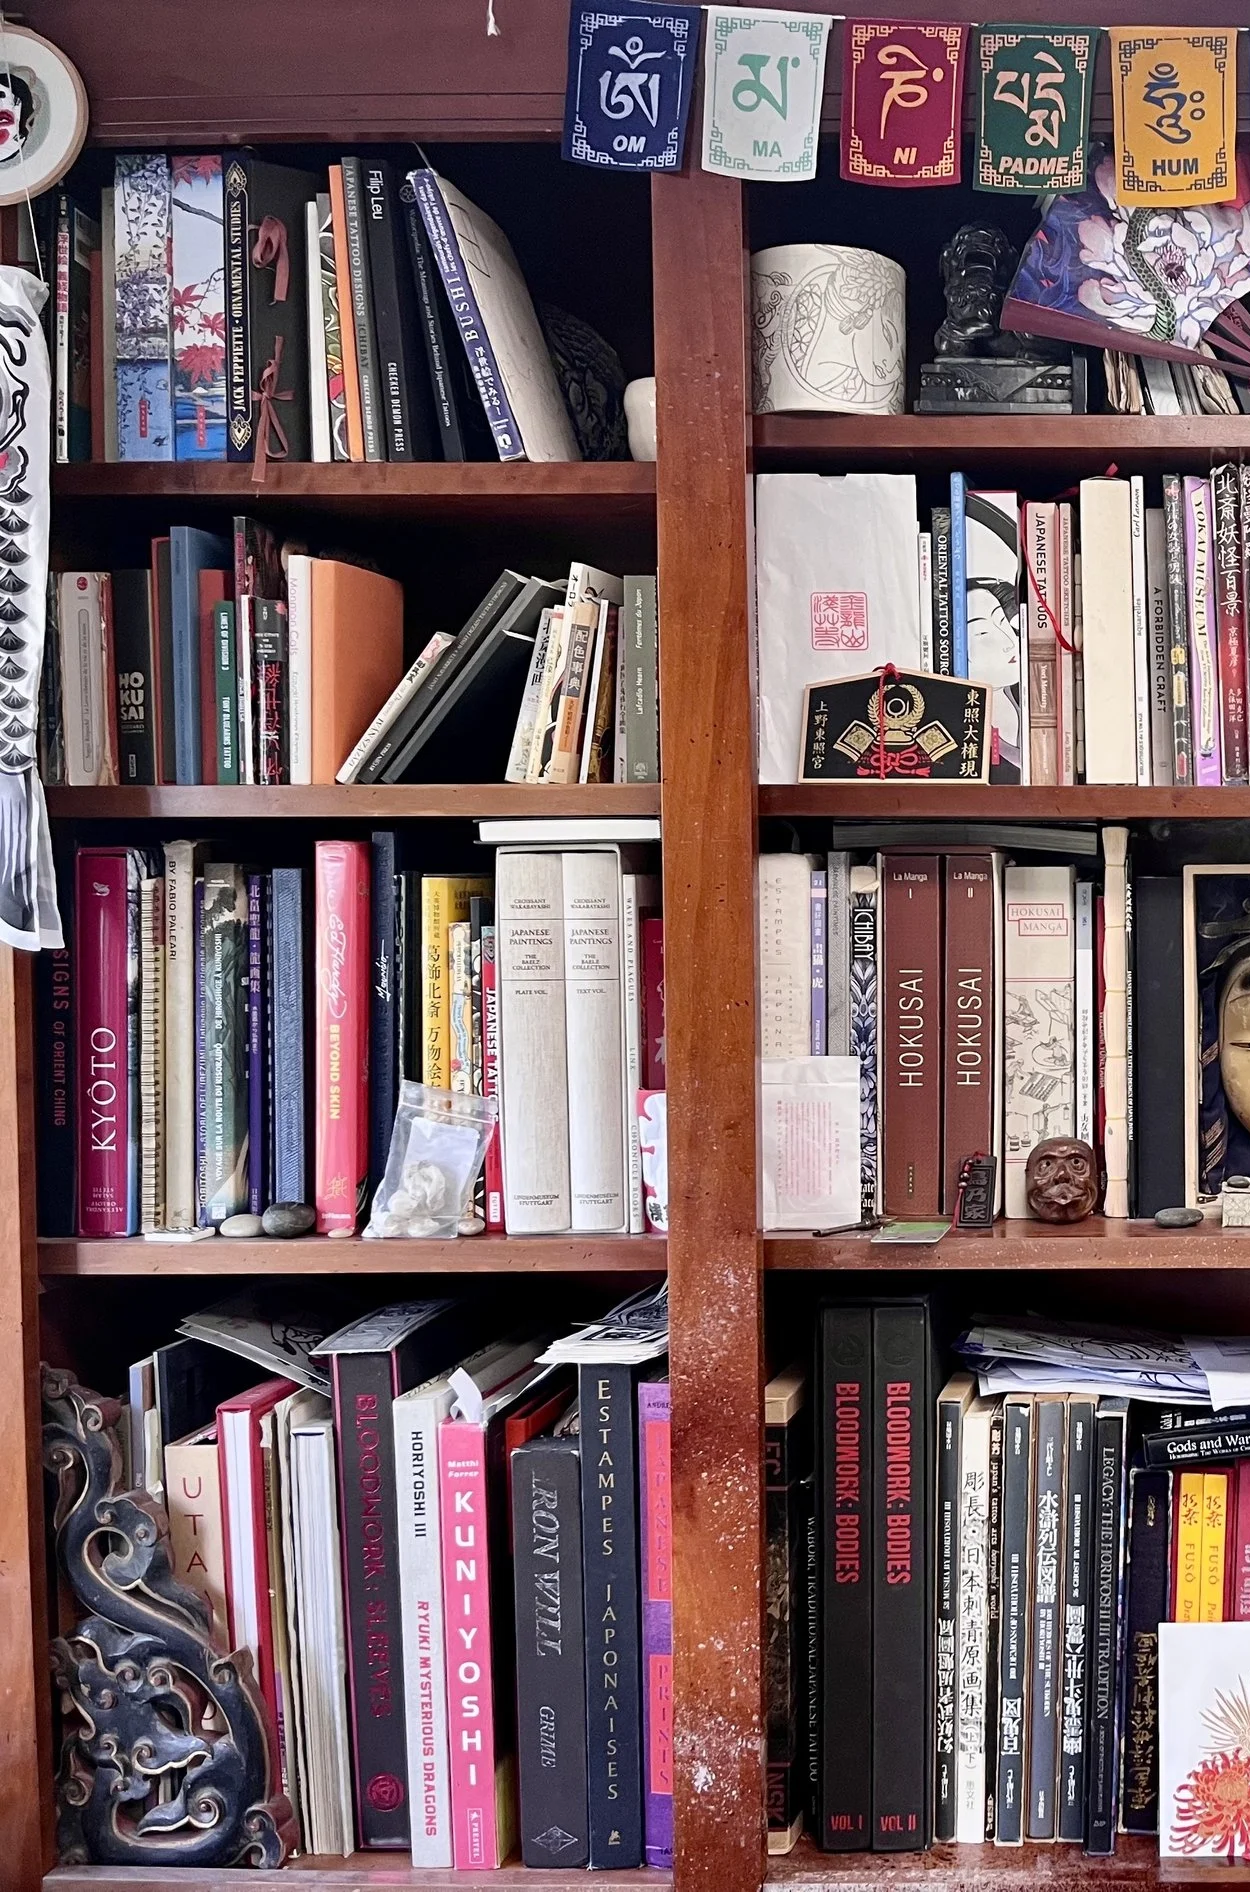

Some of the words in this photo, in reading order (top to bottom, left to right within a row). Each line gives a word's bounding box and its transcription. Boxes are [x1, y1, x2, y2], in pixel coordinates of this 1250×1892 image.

[613, 136, 646, 153] OM
[752, 141, 782, 157] MA
[893, 148, 916, 164] NI
[998, 157, 1068, 175] PADME
[1151, 157, 1199, 176] HUM
[344, 165, 359, 218] JAPANESE
[368, 170, 383, 194] Filip
[231, 201, 241, 244] STUDIES
[372, 196, 383, 220] Leu
[349, 219, 361, 267] TATTOO
[231, 246, 243, 318] ORNAMENTAL
[354, 270, 366, 316] DESIGNS
[447, 276, 479, 340] BUSHI
[231, 325, 245, 382] PEPPIETTE
[232, 385, 246, 411] JACK
[1036, 512, 1047, 574] JAPANESE
[1194, 500, 1206, 553] YOKAI
[1217, 472, 1242, 617] 北斎妖怪百景
[290, 578, 300, 627] Monmon
[1036, 577, 1048, 629] TATTOOS
[1153, 587, 1161, 595] A
[1194, 560, 1207, 637] MUSEUM
[290, 631, 299, 655] Cats
[1154, 599, 1164, 669] FORBIDDEN
[119, 672, 145, 688] HO
[120, 689, 144, 704] KU
[1157, 673, 1167, 712] CRAFT
[121, 705, 144, 720] SAI
[222, 697, 230, 712] TONY
[223, 713, 231, 746] BLUEARMS
[811, 701, 829, 769] 上野東照宮
[959, 689, 981, 777] 東照大権現
[223, 747, 231, 768] TATTOO
[169, 861, 176, 876] BY
[169, 878, 177, 911] FABIO
[1010, 906, 1061, 917] HOKUSAI
[169, 915, 177, 961] PALEARI
[853, 908, 874, 960] ICHIBAY
[1023, 921, 1064, 932] MANGA
[53, 1021, 65, 1036] OF
[899, 968, 924, 1087] HOKUSAI
[957, 967, 982, 1086] HOKUSAI
[53, 1042, 66, 1084] ORIENT
[328, 1024, 340, 1083] BEYOND
[54, 1089, 66, 1126] CHING
[87, 1027, 117, 1152] KYÔTO
[328, 1084, 340, 1121] SKIN
[596, 1379, 614, 1557] ESTAMPES
[834, 1381, 860, 1510] BLOODWORK:
[885, 1381, 912, 1511] BLOODWORK:
[1167, 1441, 1197, 1454] Gods
[1199, 1438, 1222, 1449] and
[354, 1393, 386, 1595] BLOODWORK:
[834, 1514, 860, 1586] BODIES
[886, 1514, 911, 1586] BODIES
[416, 1600, 431, 1656] RYUKI
[453, 1490, 483, 1787] KUNIYOSHI
[368, 1599, 393, 1720] SLEEVES
[418, 1658, 435, 1758] MYSTERIOUS
[601, 1583, 619, 1801] JAPONAISES
[421, 1761, 437, 1838] DRAGONS
